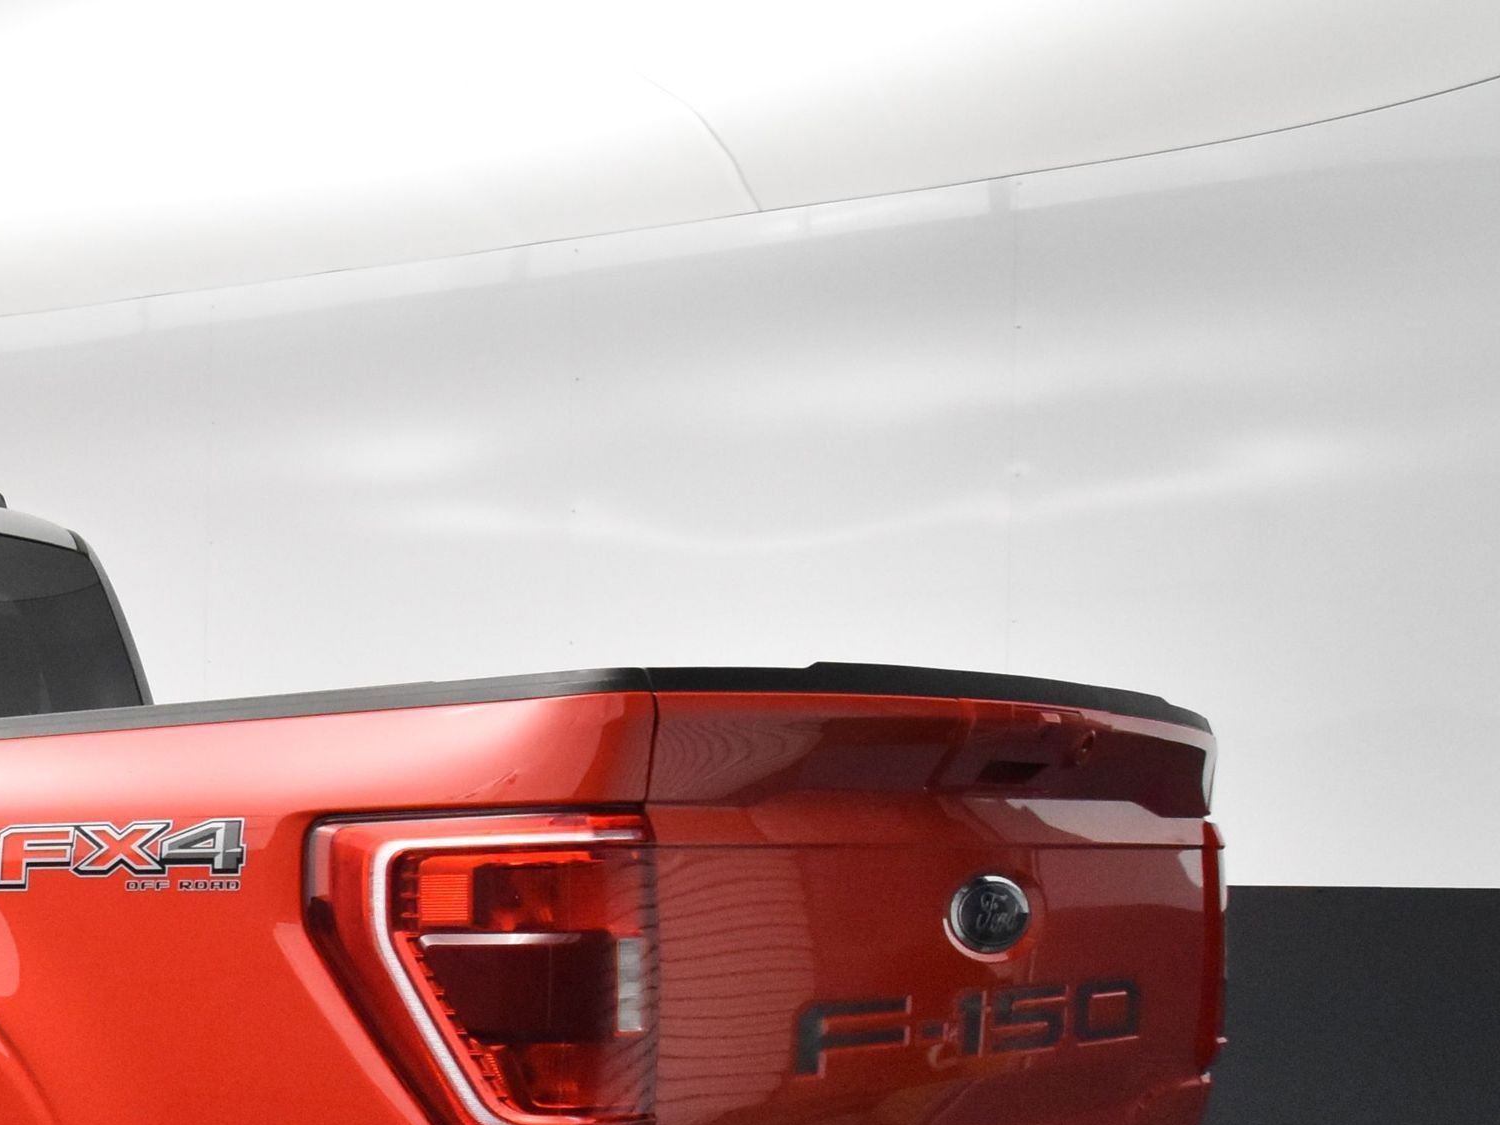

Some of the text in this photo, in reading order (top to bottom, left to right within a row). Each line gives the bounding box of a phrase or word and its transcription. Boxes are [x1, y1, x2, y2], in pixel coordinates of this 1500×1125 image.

[125, 879, 240, 891] OFF ROAD
[794, 981, 1141, 1078] F-150
